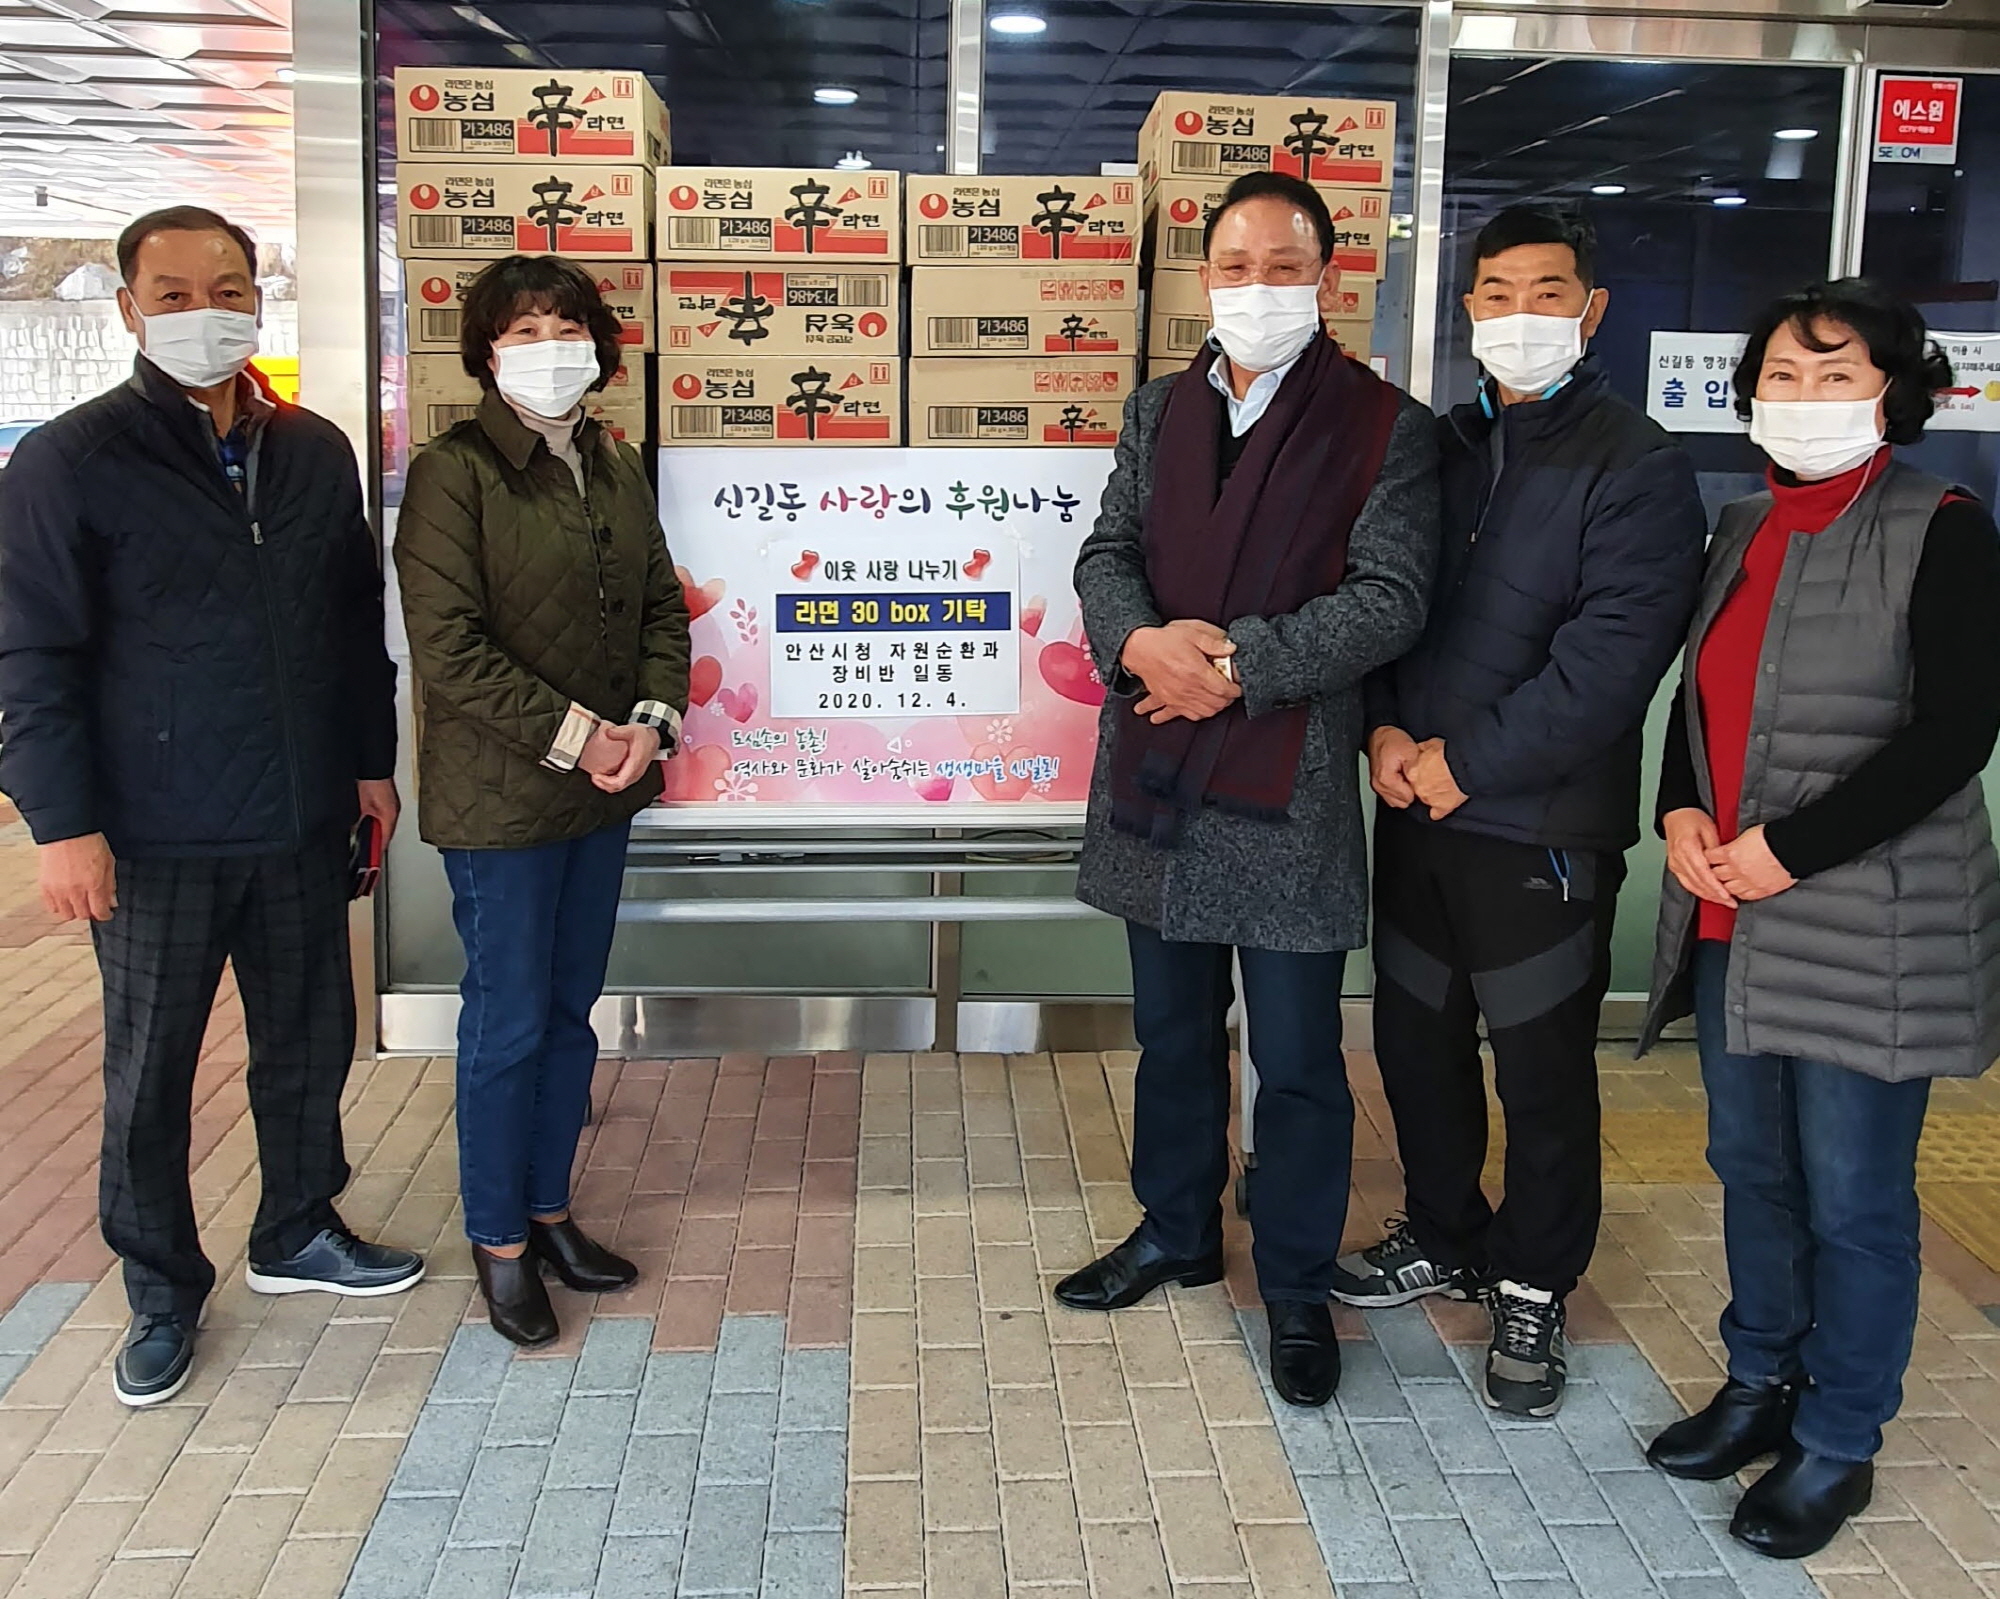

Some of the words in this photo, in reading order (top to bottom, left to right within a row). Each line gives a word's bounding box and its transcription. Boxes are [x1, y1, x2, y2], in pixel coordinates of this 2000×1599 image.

[443, 91, 494, 112] 농심
[1892, 99, 1945, 122] 에스원
[527, 78, 588, 157] 辛
[586, 115, 625, 132] 라면
[1206, 116, 1255, 137] 농심
[1283, 107, 1340, 181] 辛
[1339, 143, 1375, 159] 라면
[443, 188, 495, 209] 농심
[702, 191, 753, 210] 농심
[951, 198, 1001, 218] 농심
[527, 175, 588, 252] 辛
[585, 211, 625, 227] 라면
[785, 177, 844, 254] 辛
[842, 213, 881, 230] 라면
[1031, 184, 1089, 260] 辛
[1088, 220, 1125, 236] 라면
[1334, 231, 1371, 246] 라면
[611, 305, 636, 319] 면
[678, 295, 717, 311] 라면
[715, 270, 774, 347] 辛
[805, 313, 854, 333] 농심
[1060, 313, 1090, 352] 辛
[1659, 355, 1695, 369] 신길동
[705, 379, 755, 399] 농심
[786, 365, 845, 441] 辛
[843, 400, 882, 416] 라면
[1060, 404, 1089, 442] 辛
[714, 482, 807, 522] 신길동
[819, 483, 932, 520] 사랑의
[946, 480, 1081, 523] 후원나눔
[824, 559, 857, 582] 이웃
[867, 559, 899, 582] 사랑
[909, 559, 957, 582] 나누기
[795, 600, 840, 625] 라면
[852, 601, 880, 623] 30
[891, 601, 931, 623] box
[942, 599, 987, 624] 기탁
[785, 642, 872, 661] 안산시청
[890, 640, 999, 661] 자원순환과
[832, 664, 895, 684] 장비반
[913, 664, 953, 683] 일동
[818, 693, 882, 710] 2020.
[897, 693, 932, 709] 12.
[946, 692, 966, 708] 4.
[731, 730, 787, 751] 도심속의
[796, 728, 829, 751] 농촌!
[733, 761, 789, 777] 역사와
[796, 759, 845, 777] 문화가
[851, 758, 931, 781] 살아숨쉬는
[936, 757, 1005, 781] 생생마을
[1010, 757, 1060, 781] 신길동!
